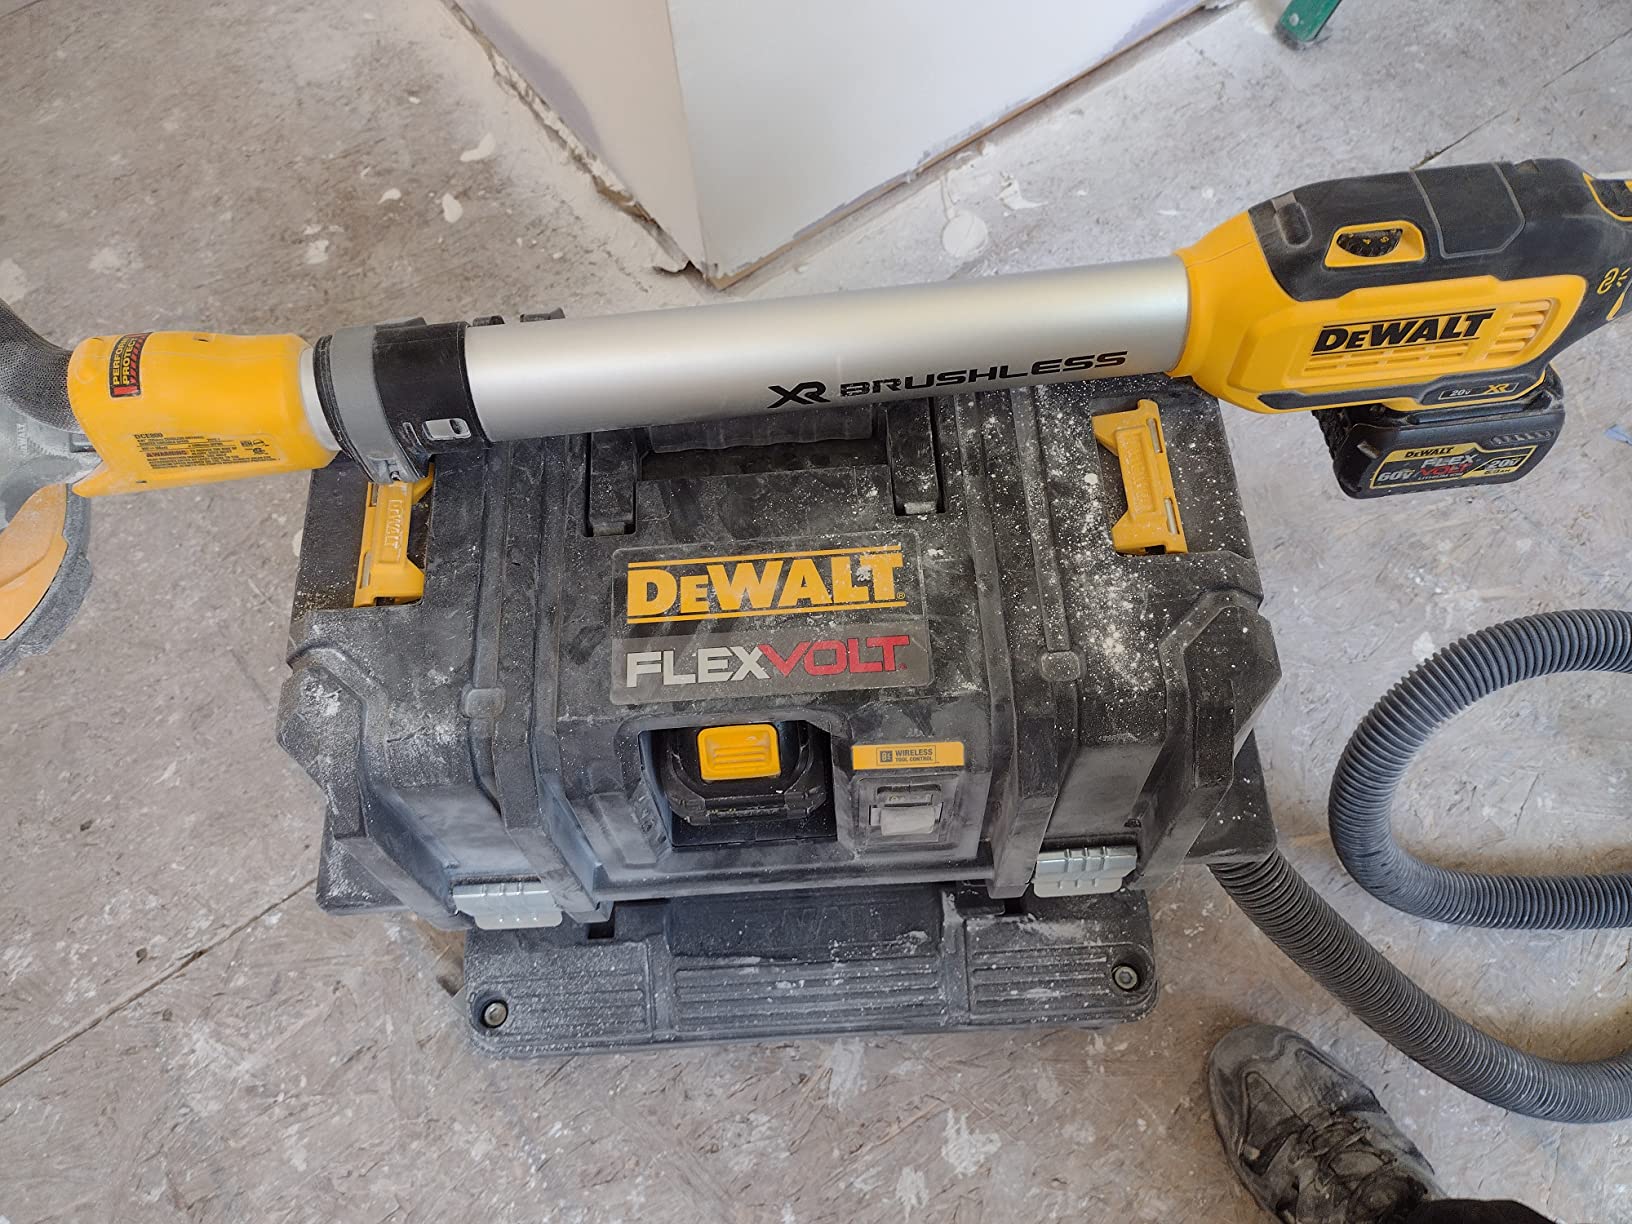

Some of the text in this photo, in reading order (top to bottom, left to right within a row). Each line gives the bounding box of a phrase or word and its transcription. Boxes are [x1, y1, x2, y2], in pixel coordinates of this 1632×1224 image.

[1312, 310, 1495, 354] DEWALT
[767, 350, 1129, 409] XR BRUSHLESS
[1404, 446, 1455, 459] DEWALT
[1420, 463, 1473, 477] VOLT
[626, 634, 910, 688] FLEXVOLT
[895, 748, 933, 757] WIRELESS
